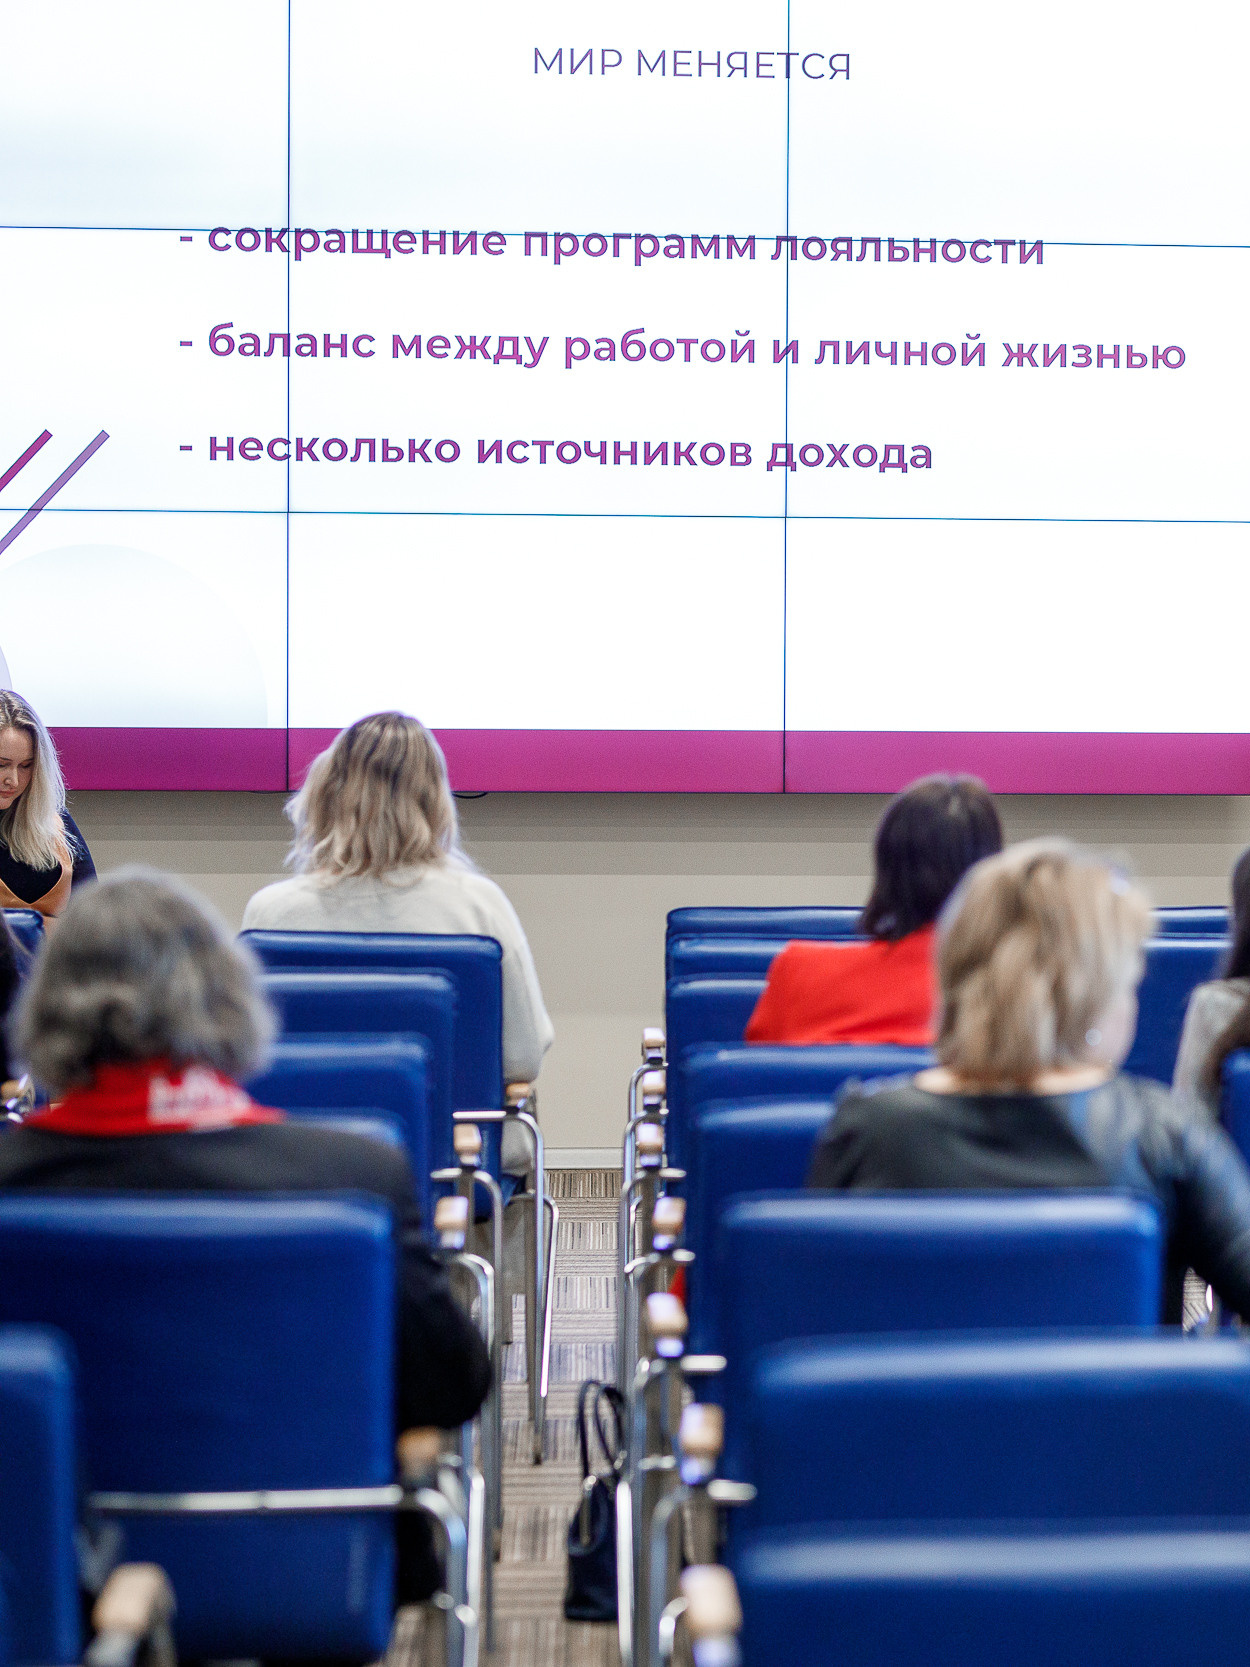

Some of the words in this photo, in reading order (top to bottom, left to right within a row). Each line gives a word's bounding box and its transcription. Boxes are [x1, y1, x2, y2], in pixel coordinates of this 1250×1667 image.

[534, 47, 623, 76] МИР
[637, 49, 850, 80] МЕНЯЕТСЯ
[208, 226, 507, 261] сокращение
[524, 231, 756, 267] программ
[770, 235, 1044, 265] лояльности
[208, 322, 376, 358] баланс
[392, 334, 549, 369] между
[565, 328, 755, 369] работой
[773, 339, 799, 364] и
[814, 333, 986, 367] личной
[1002, 343, 1186, 369] жизнью
[209, 436, 461, 463] несколько
[477, 439, 753, 467] источников
[766, 443, 933, 474] дохода
